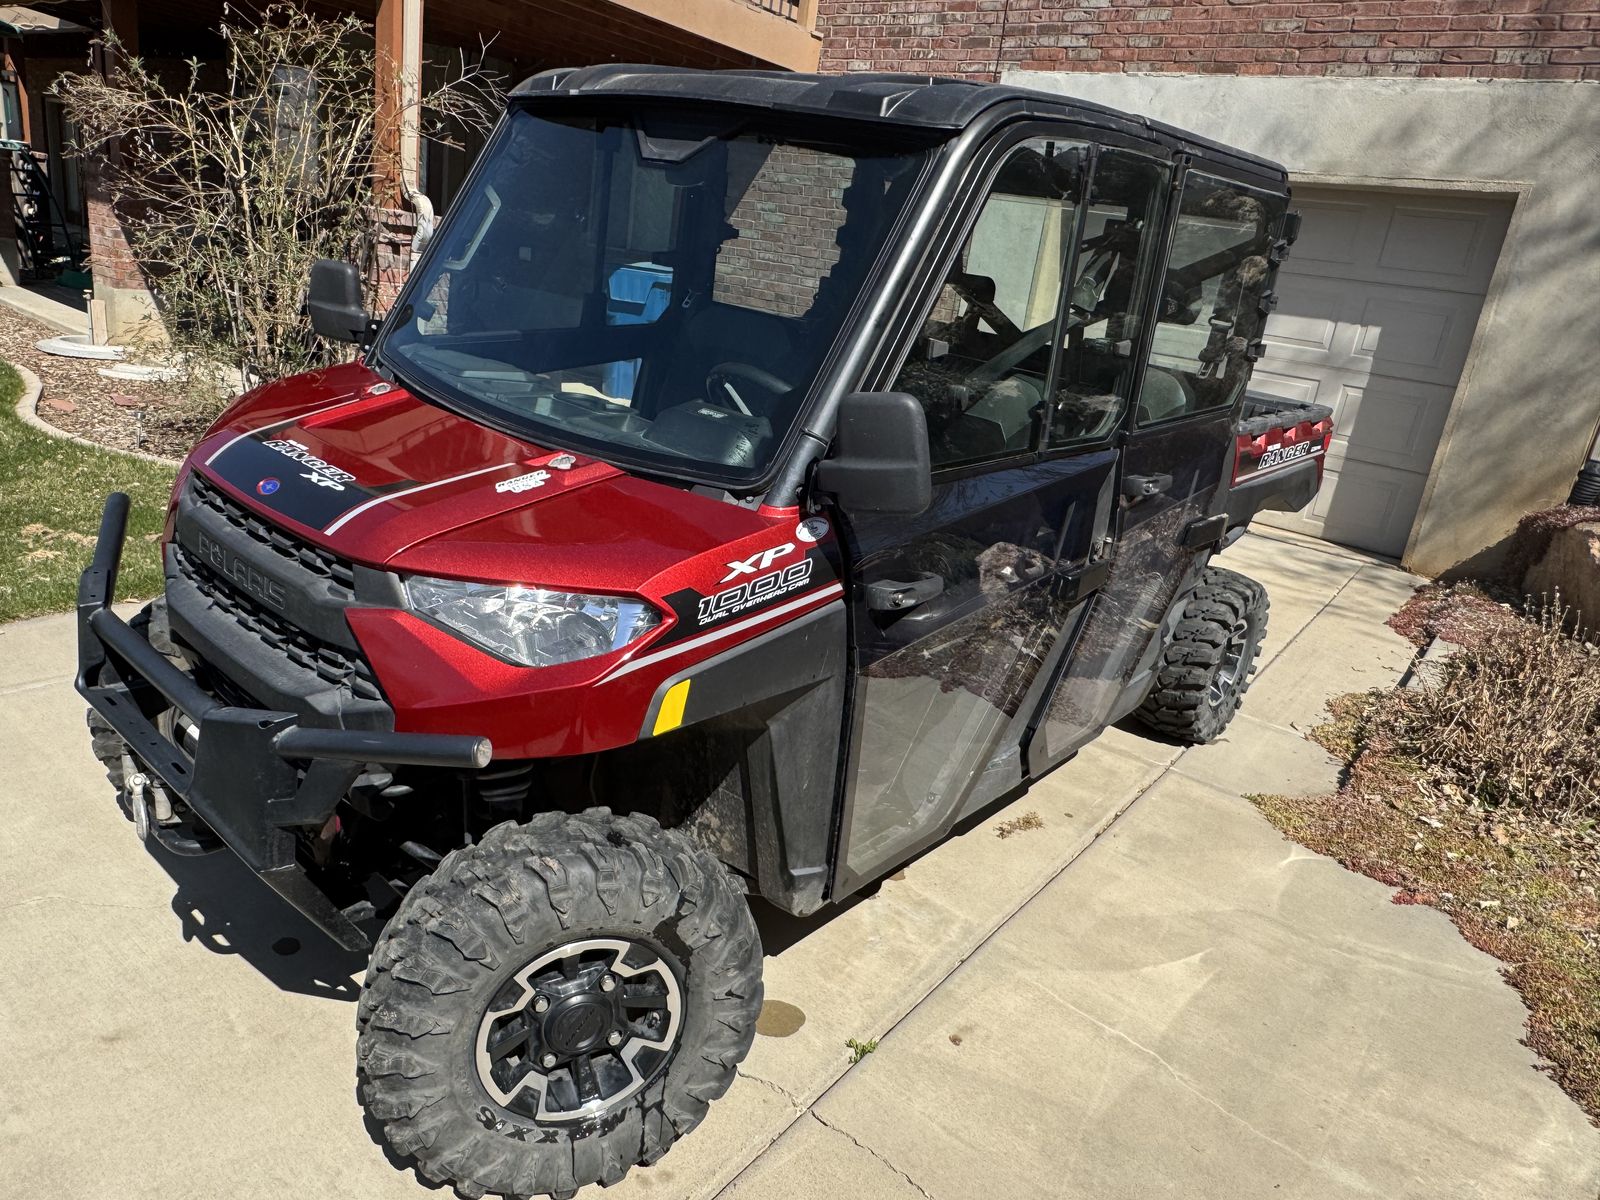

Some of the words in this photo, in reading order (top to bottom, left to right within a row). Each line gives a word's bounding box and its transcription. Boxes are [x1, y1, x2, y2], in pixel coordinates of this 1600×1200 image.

[262, 440, 356, 482] RANGER
[1258, 441, 1310, 469] RANGER
[299, 471, 345, 491] XP
[199, 532, 286, 610] POLARIS
[719, 542, 796, 584] XP
[697, 558, 813, 619] 1000
[699, 611, 730, 626] DUAL
[731, 585, 788, 613] OVERHEAD
[788, 577, 811, 592] CAM
